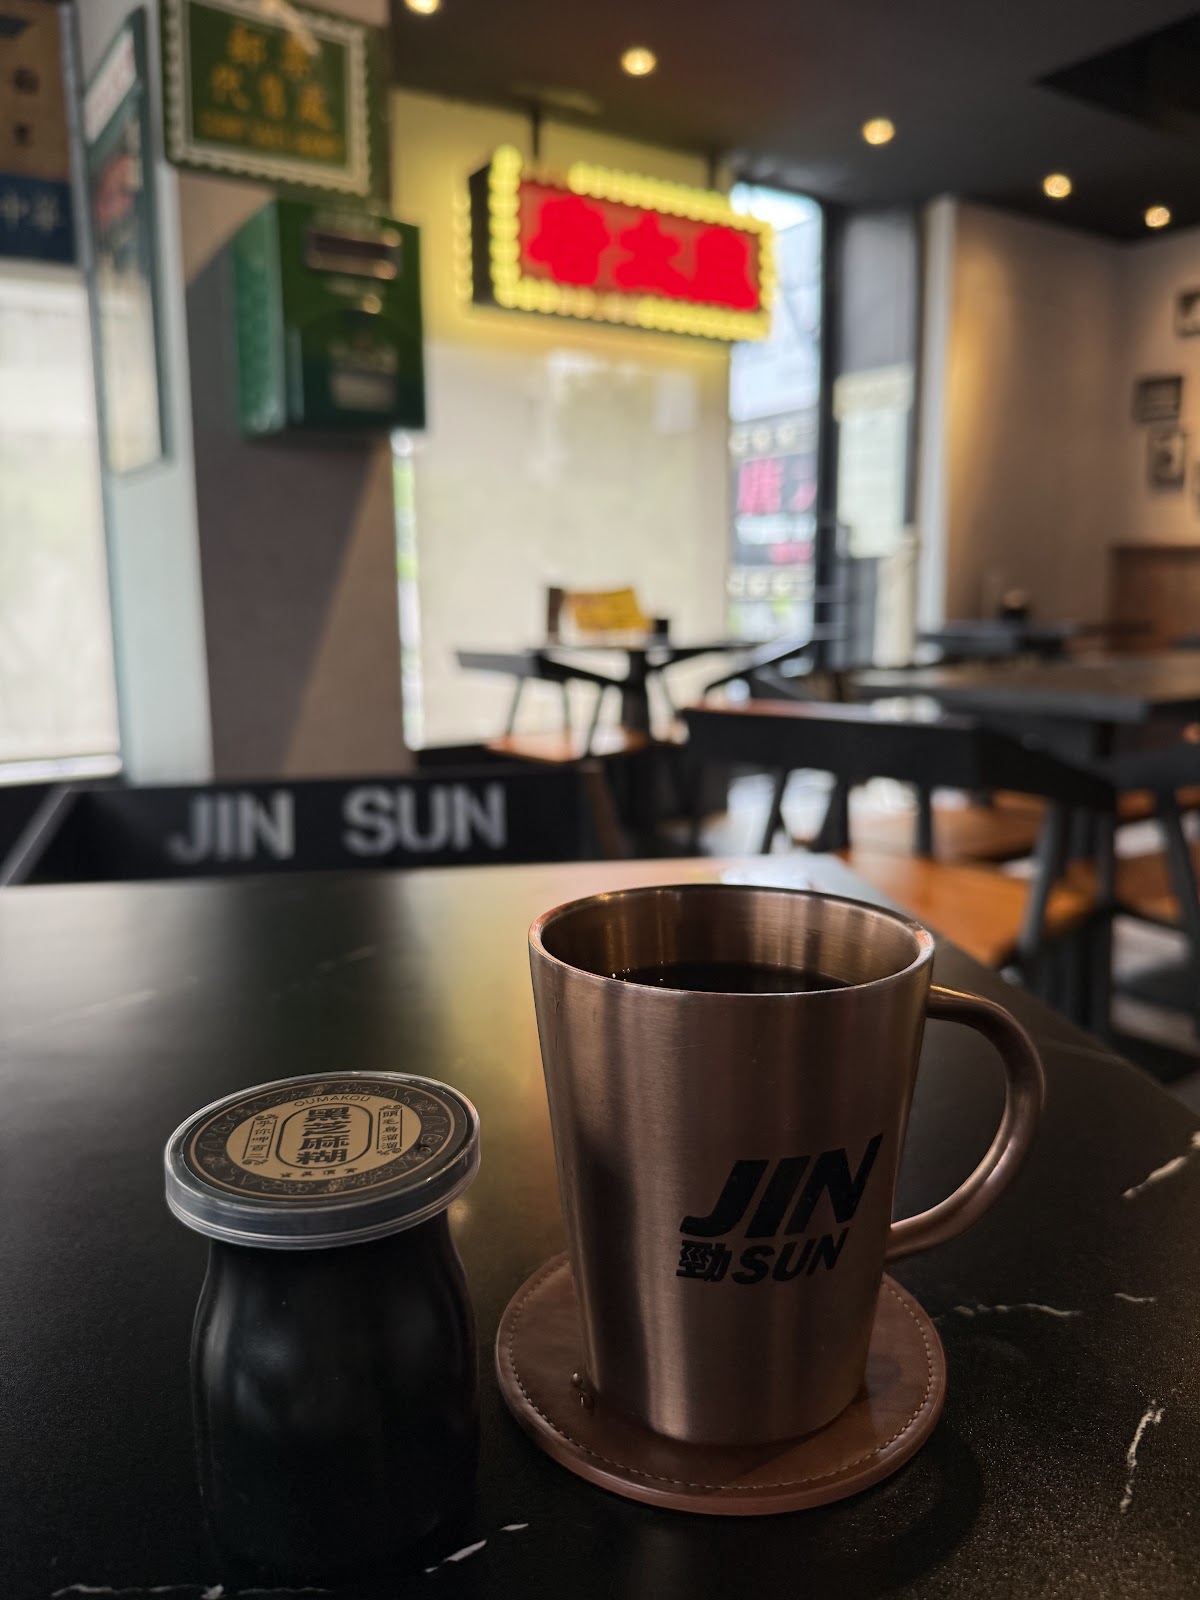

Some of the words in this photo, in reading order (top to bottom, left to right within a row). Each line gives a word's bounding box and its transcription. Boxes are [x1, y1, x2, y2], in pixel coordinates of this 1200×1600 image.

[167, 789, 296, 865] JIN
[341, 781, 507, 856] SUN
[294, 1095, 371, 1107] OUMAKOU
[296, 1106, 352, 1164] 黑芝麻糊
[679, 1132, 884, 1238] JIN
[731, 1227, 850, 1284] SUN
